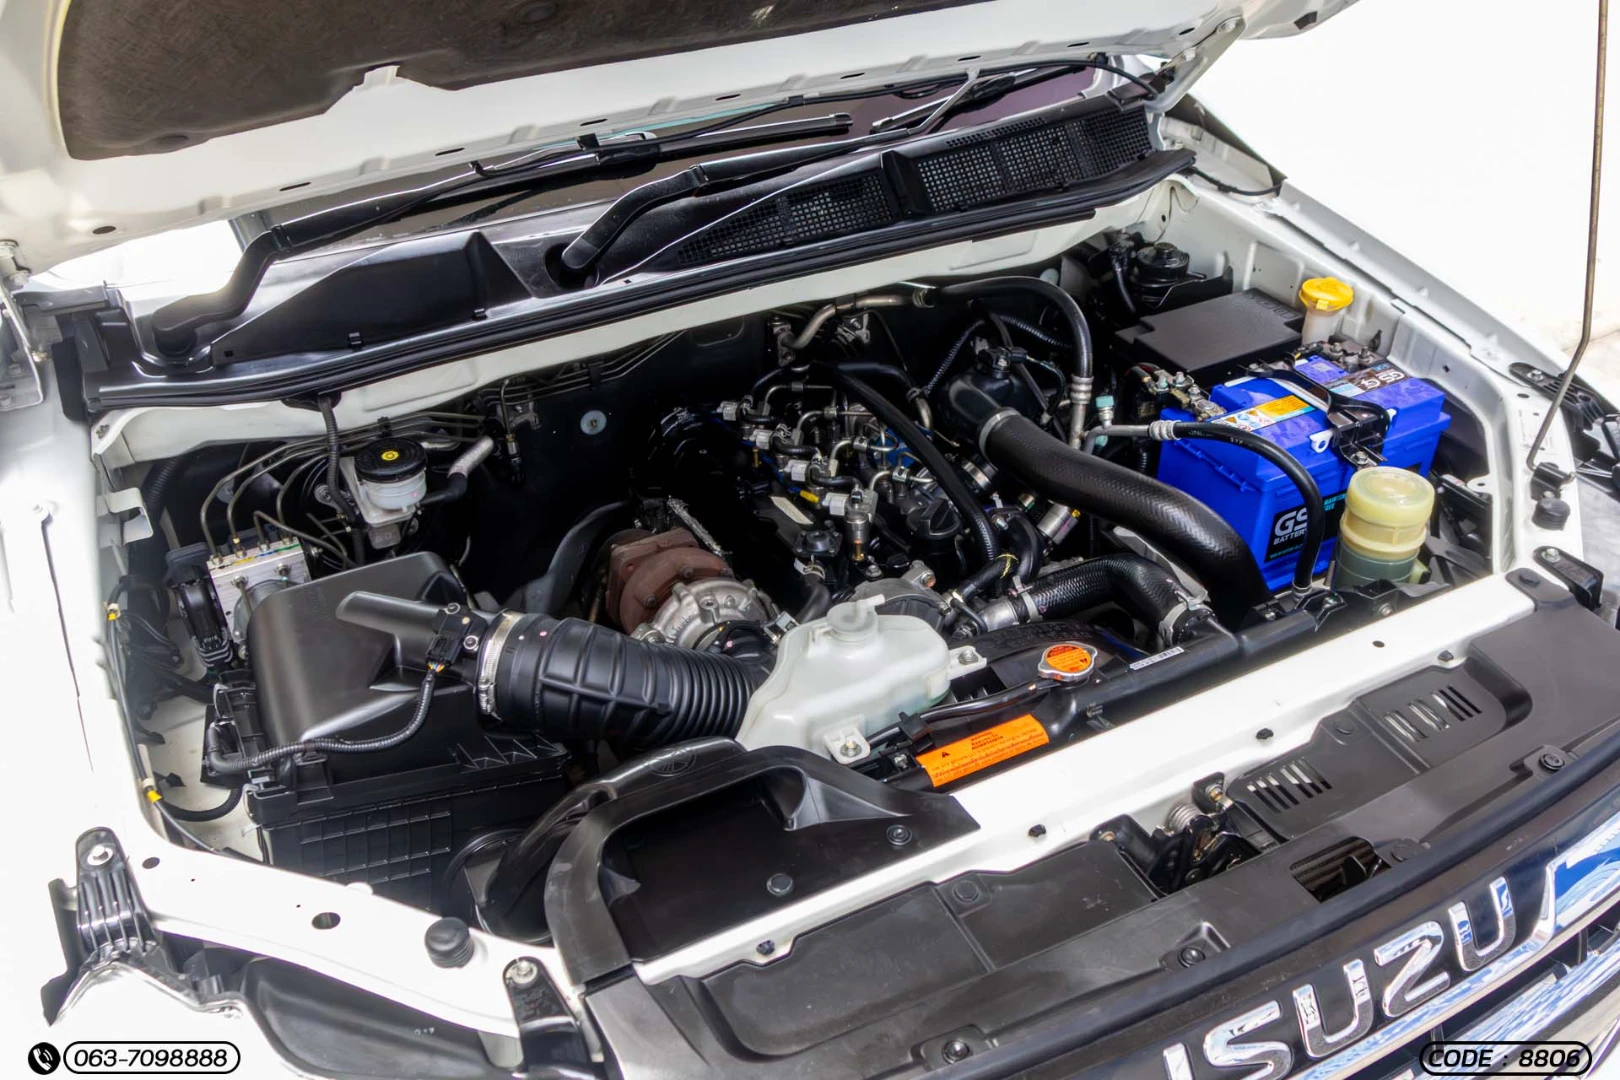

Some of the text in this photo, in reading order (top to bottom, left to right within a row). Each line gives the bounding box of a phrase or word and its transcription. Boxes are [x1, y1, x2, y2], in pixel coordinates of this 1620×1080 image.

[1273, 528, 1307, 545] BATTER
[1274, 507, 1308, 537] GS
[1162, 876, 1518, 1080] ISUZU
